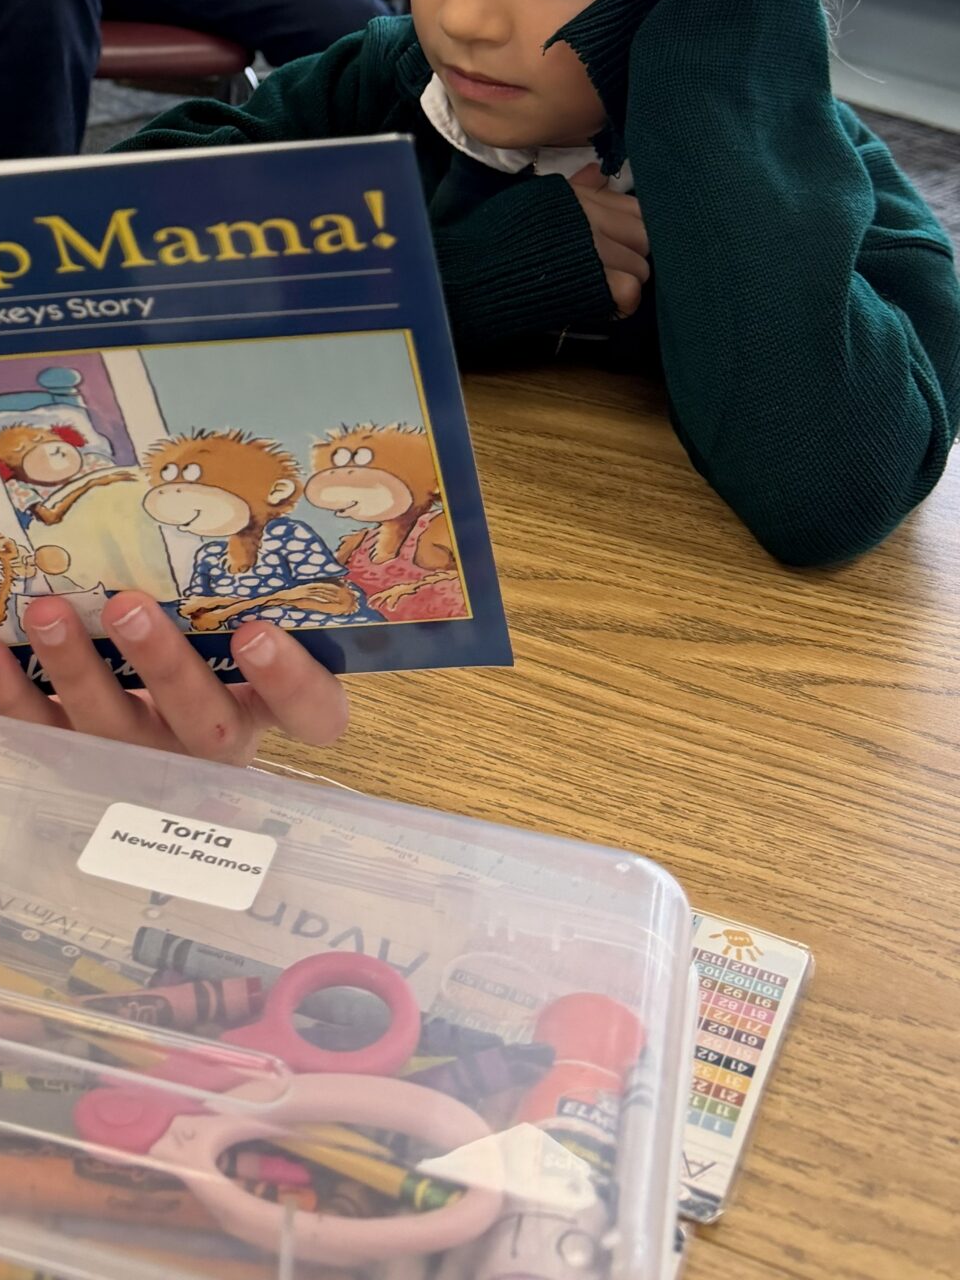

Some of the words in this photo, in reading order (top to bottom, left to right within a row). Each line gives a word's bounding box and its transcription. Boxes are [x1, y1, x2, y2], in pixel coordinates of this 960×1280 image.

[34, 190, 399, 275] Mama!
[66, 292, 155, 321] Story
[111, 829, 262, 876] Newell-Ramos
[160, 818, 233, 849] Toria
